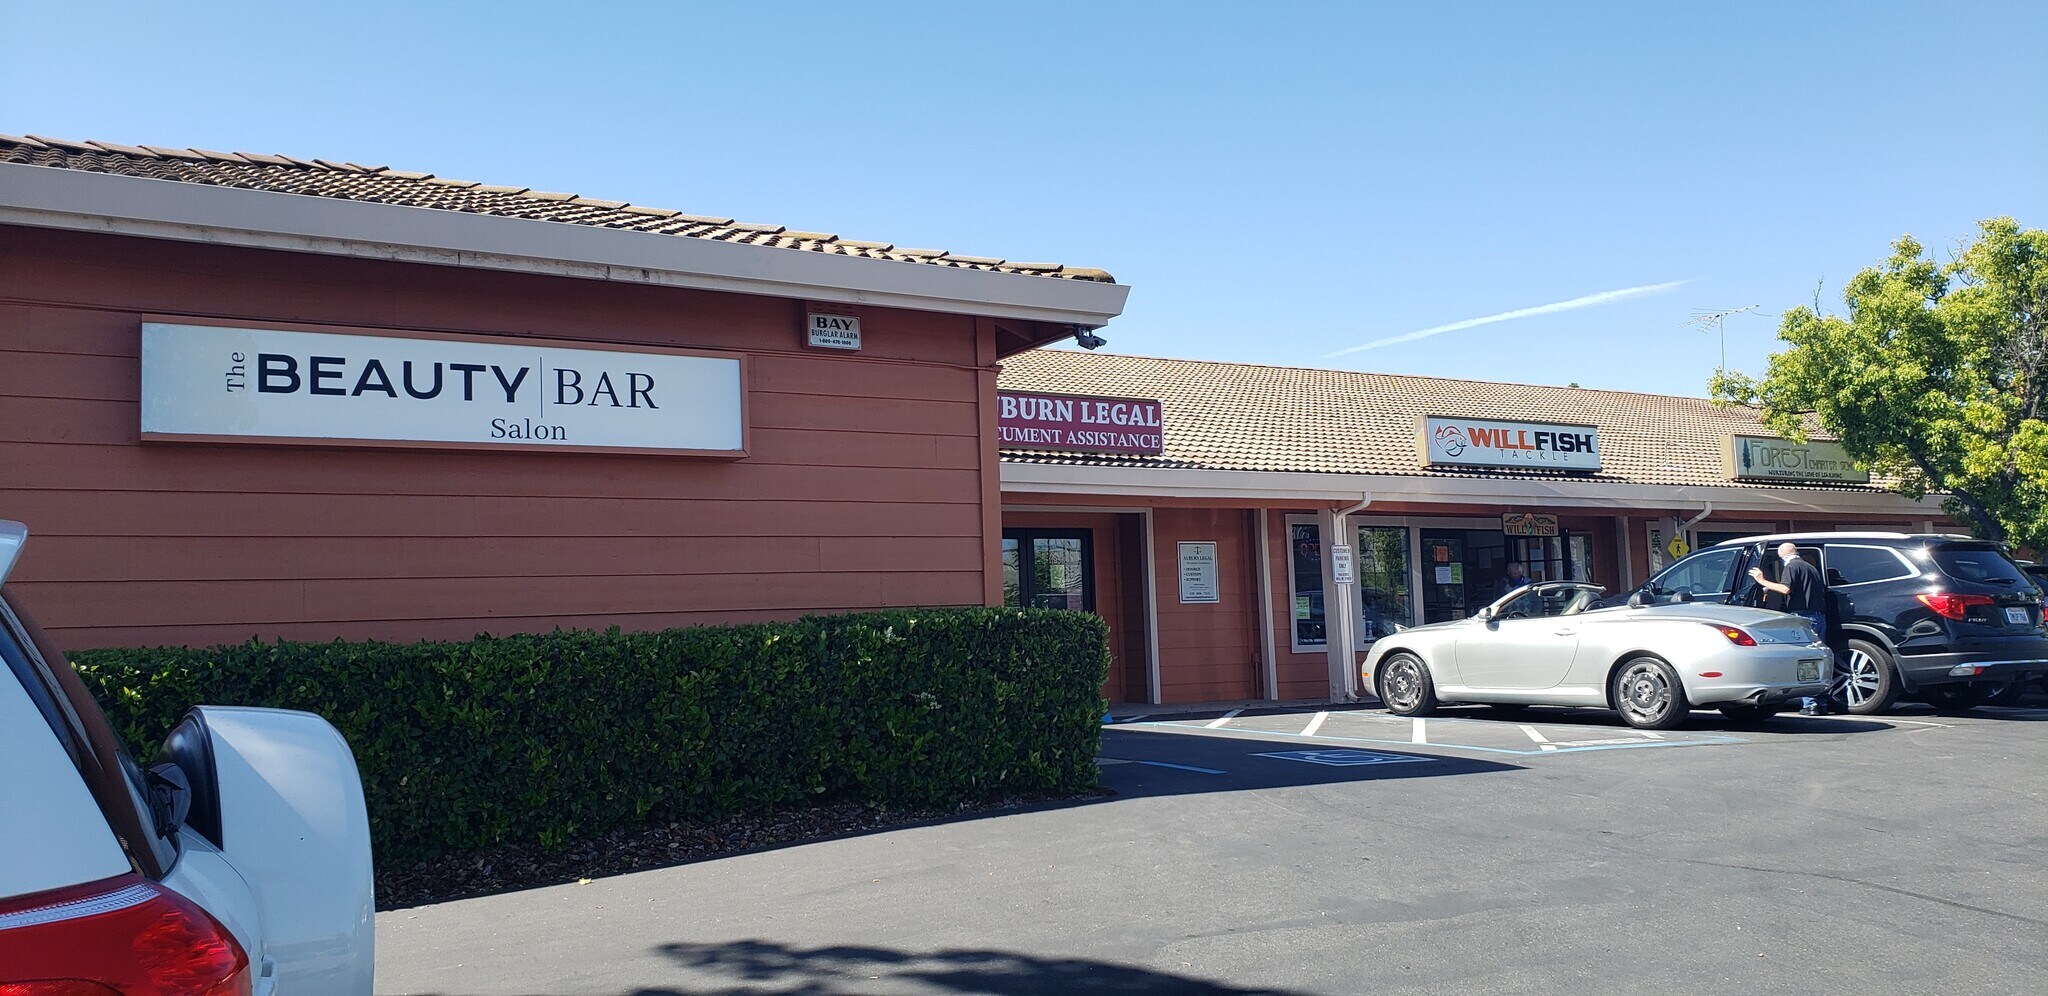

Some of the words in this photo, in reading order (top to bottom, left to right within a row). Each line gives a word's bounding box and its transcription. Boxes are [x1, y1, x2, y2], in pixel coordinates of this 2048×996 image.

[812, 329, 839, 338] BURGLAR
[817, 317, 853, 330] BAY
[225, 350, 247, 394] The
[257, 352, 532, 405] BEAUTY
[552, 367, 661, 411] BAR
[997, 396, 1074, 423] BURN
[1080, 401, 1160, 427] LEGAL
[490, 417, 568, 442] Salon
[1066, 430, 1161, 449] ASSISTANCE
[1467, 427, 1596, 454] WILLFISH
[1500, 449, 1569, 461] TACKLE
[1749, 439, 1810, 470] FOREST
[1840, 460, 1856, 471] SCH
[1505, 525, 1526, 534] WILL
[1536, 526, 1555, 535] FISH
